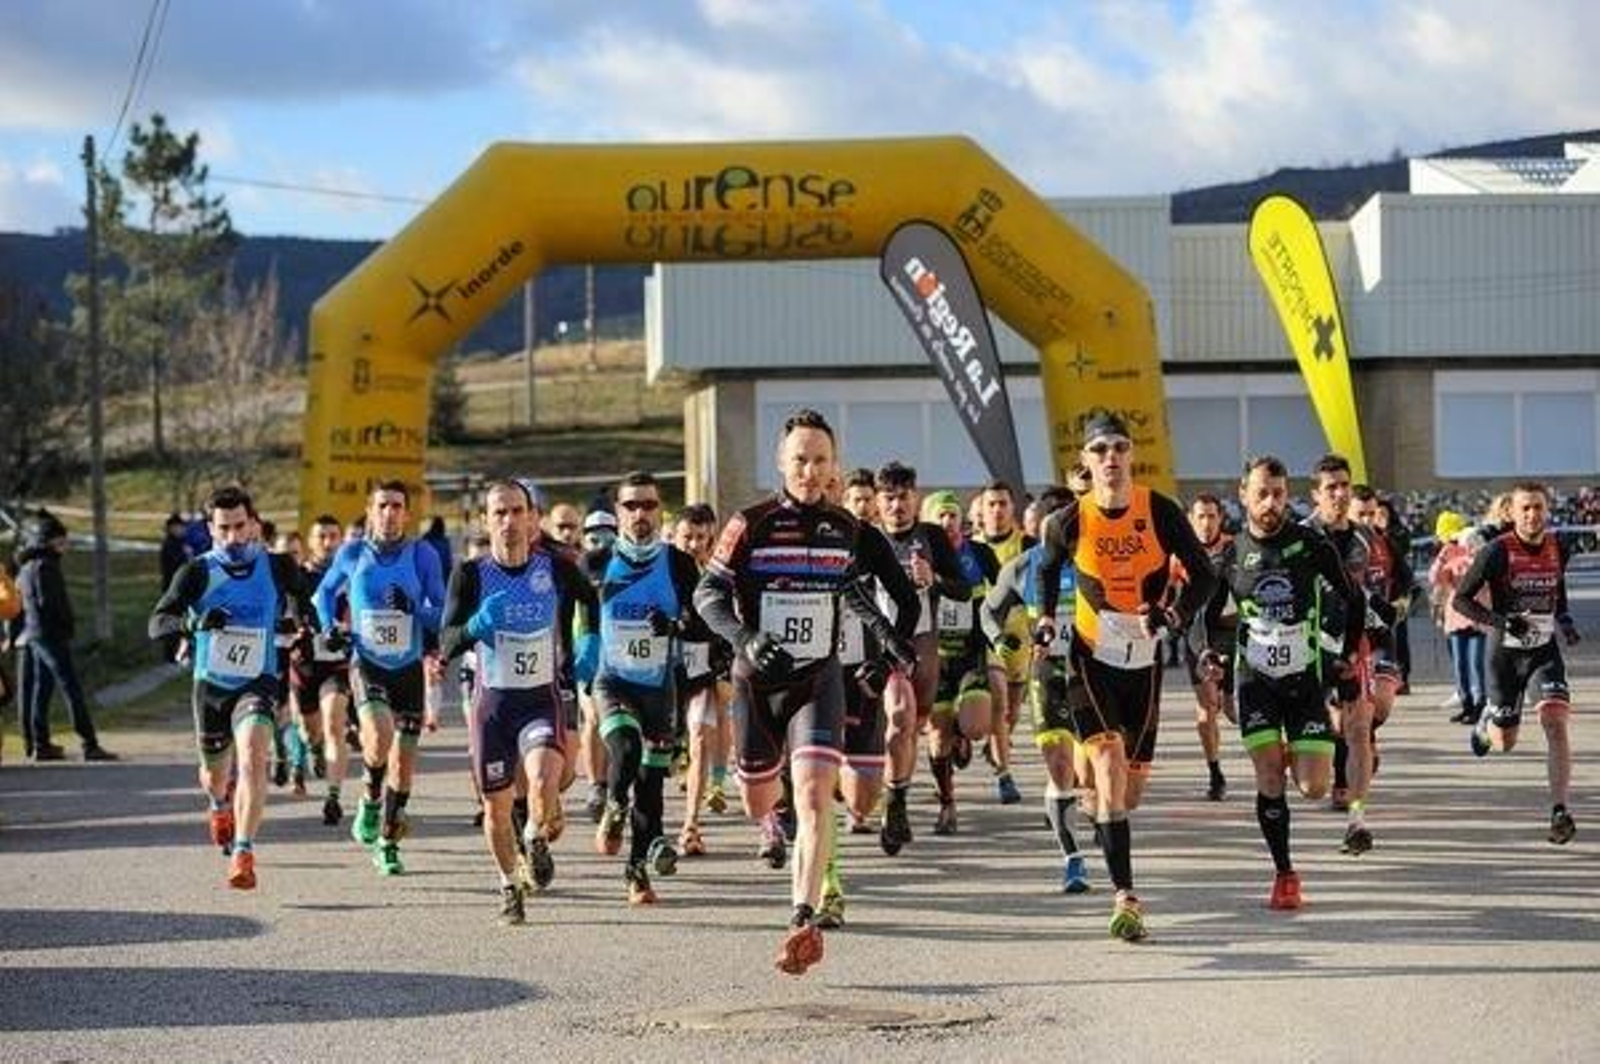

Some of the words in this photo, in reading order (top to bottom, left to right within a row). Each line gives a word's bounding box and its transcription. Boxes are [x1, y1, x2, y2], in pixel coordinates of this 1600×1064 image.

[626, 166, 856, 211] ourense
[457, 240, 525, 299] inorde
[1095, 535, 1148, 556] SOUSA
[375, 625, 398, 646] 38
[785, 616, 814, 645] 68
[227, 643, 250, 665] 47
[627, 638, 651, 659] 46
[1267, 645, 1292, 667] 39
[514, 651, 538, 675] 52
